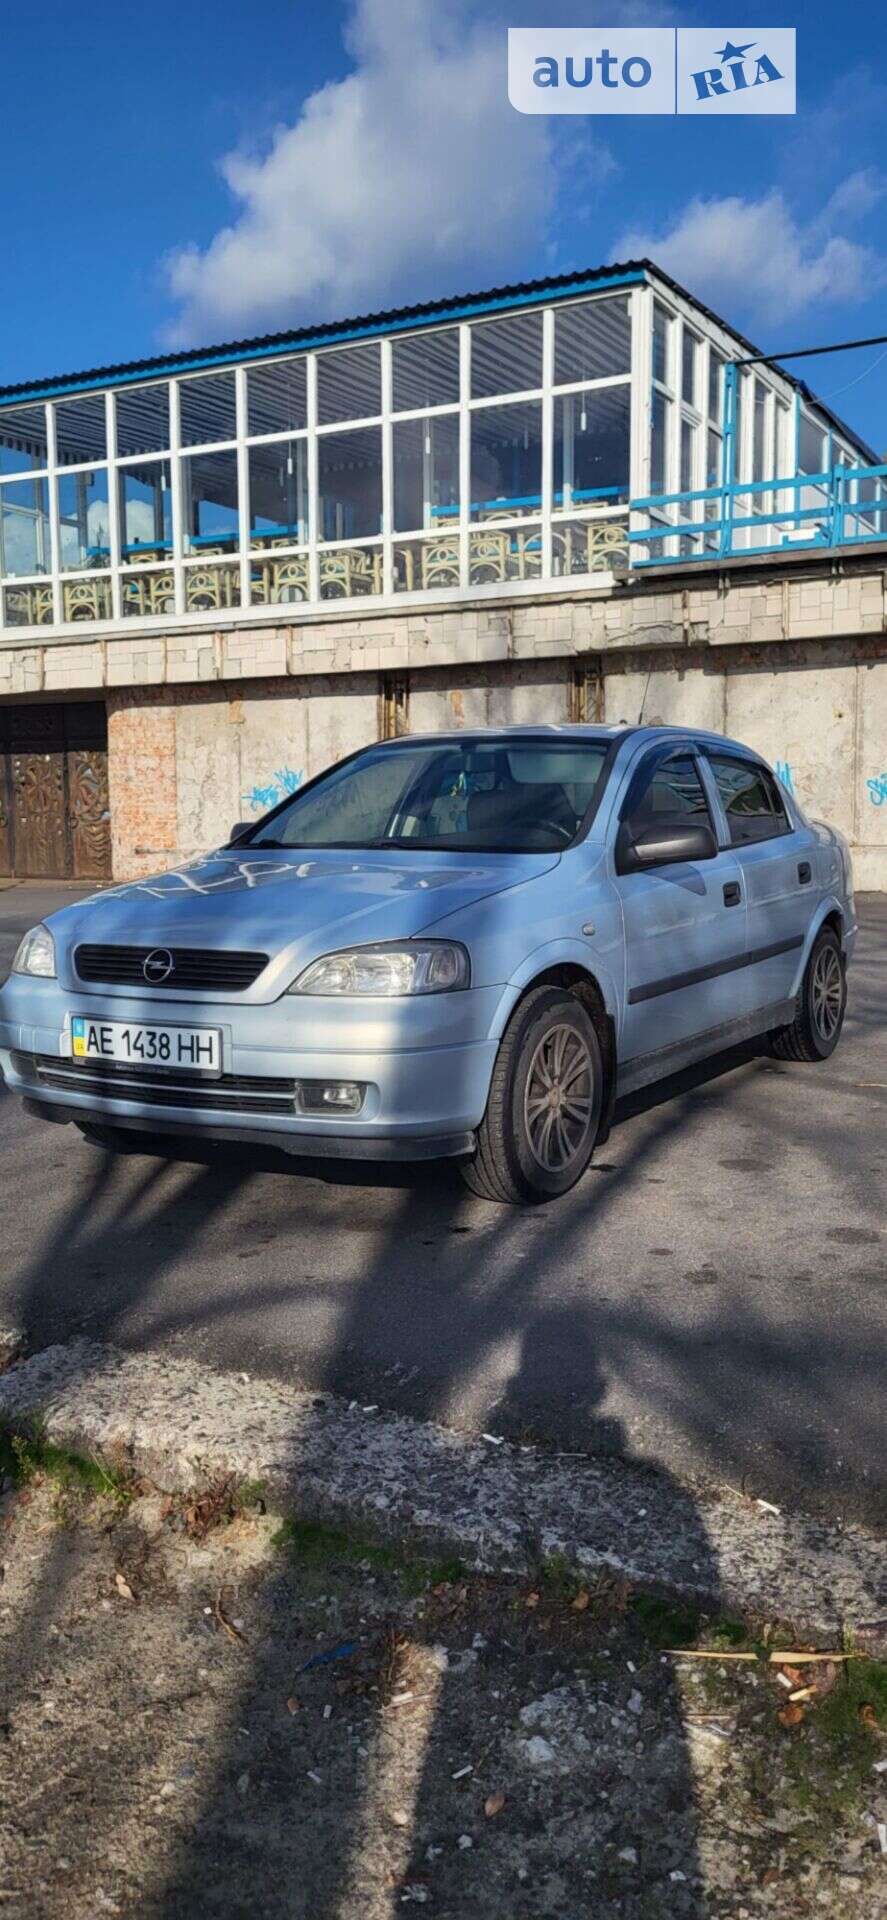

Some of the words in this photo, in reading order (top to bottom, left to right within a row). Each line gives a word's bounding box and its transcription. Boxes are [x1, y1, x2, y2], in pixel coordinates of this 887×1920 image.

[87, 1025, 115, 1055] AE
[121, 1029, 171, 1061] 1438
[177, 1033, 213, 1064] HH
